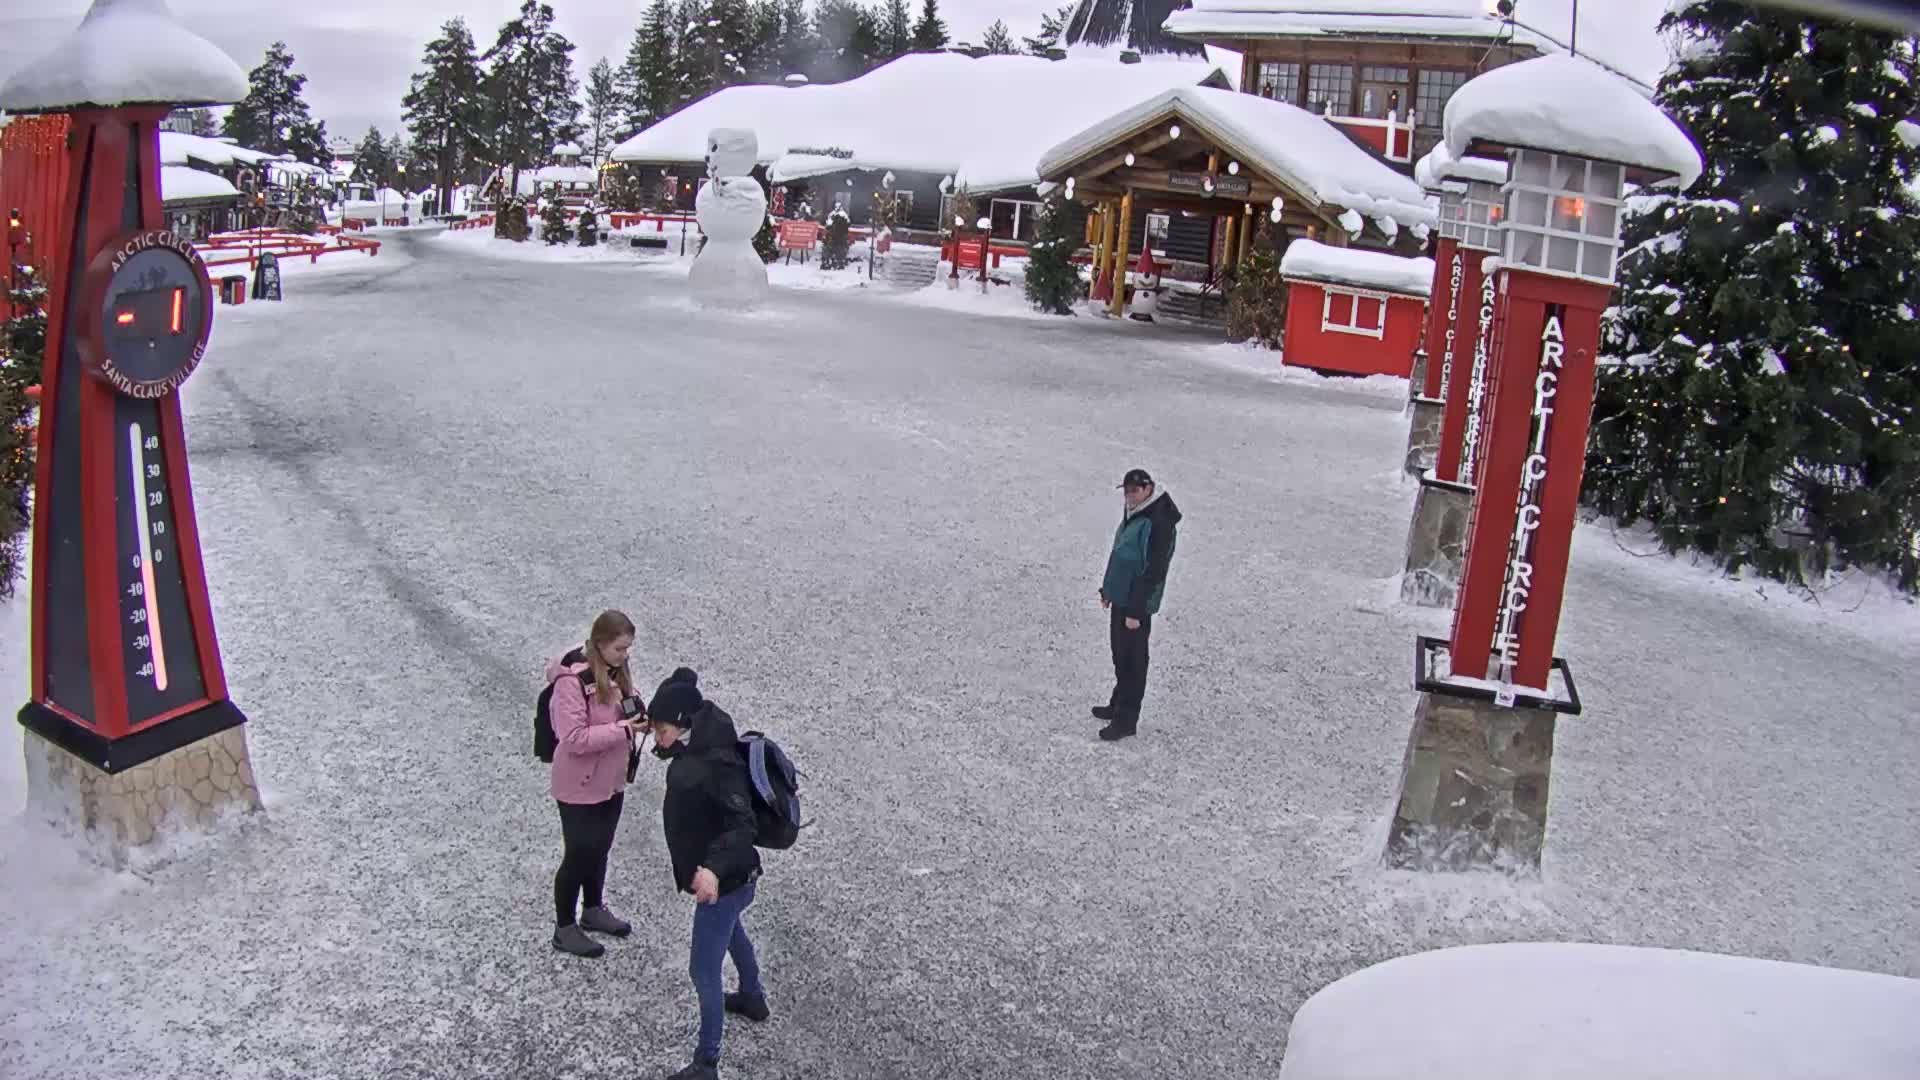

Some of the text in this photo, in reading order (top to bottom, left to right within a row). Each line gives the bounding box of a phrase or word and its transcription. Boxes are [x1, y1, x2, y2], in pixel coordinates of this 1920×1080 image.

[112, 232, 198, 272] ARCTIC CIRCLE
[1448, 254, 1462, 321] ARCTIC
[169, 342, 205, 390] VILLAGE
[1526, 316, 1564, 482] ARCTIC
[145, 436, 158, 450] 40
[147, 464, 160, 478] 30
[149, 491, 162, 505] 20
[152, 520, 165, 535] 10
[133, 555, 141, 568] 0
[155, 550, 162, 562] 0
[127, 583, 143, 596] -10
[129, 608, 146, 623] -20
[133, 634, 150, 649] -30
[136, 662, 154, 677] -40
